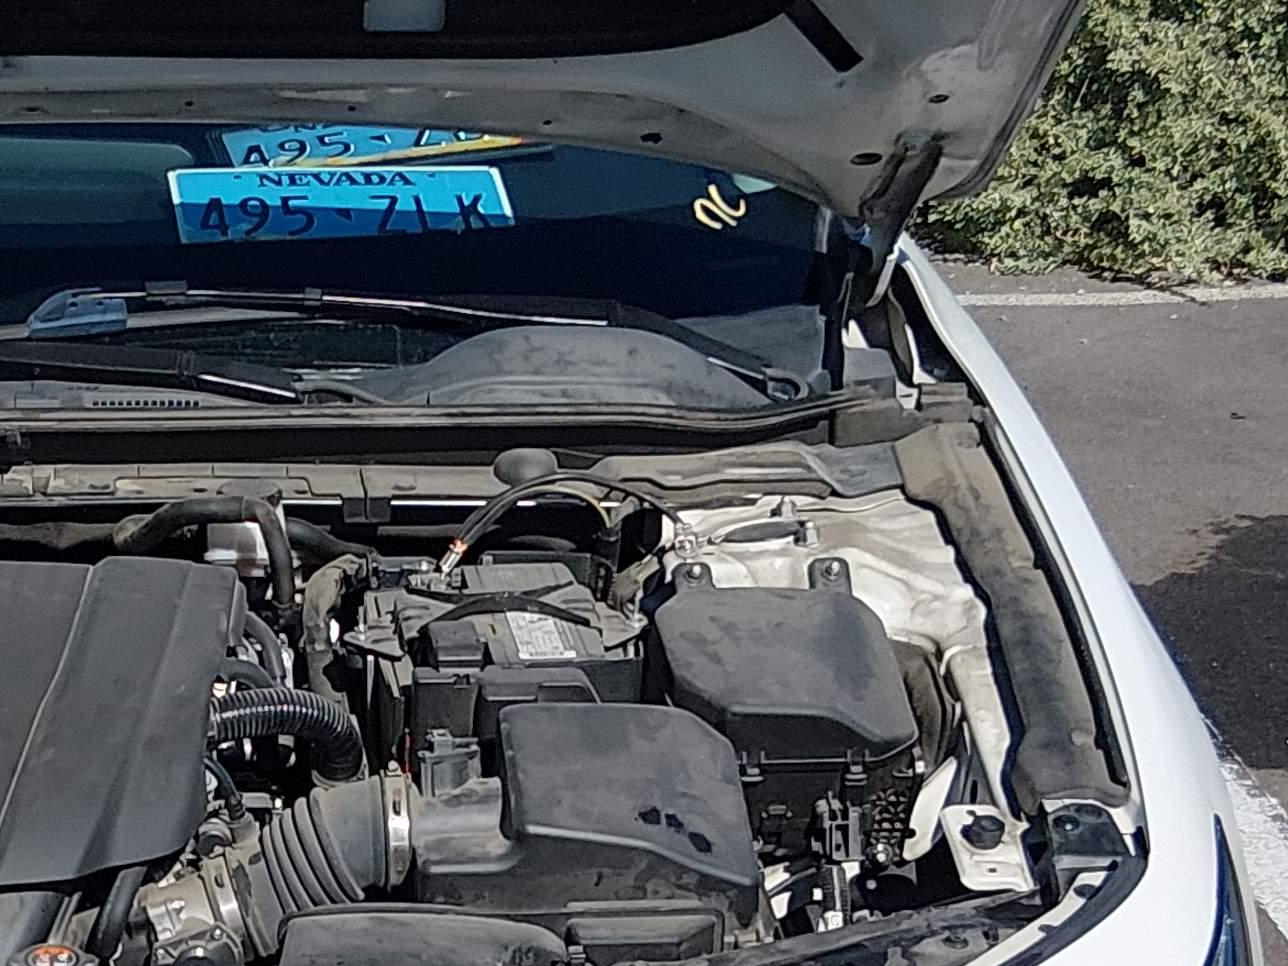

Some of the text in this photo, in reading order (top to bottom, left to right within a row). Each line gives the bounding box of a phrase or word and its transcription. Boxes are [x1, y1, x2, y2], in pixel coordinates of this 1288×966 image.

[242, 132, 352, 166] 495
[258, 171, 415, 187] NEVADA
[199, 194, 316, 237] 495
